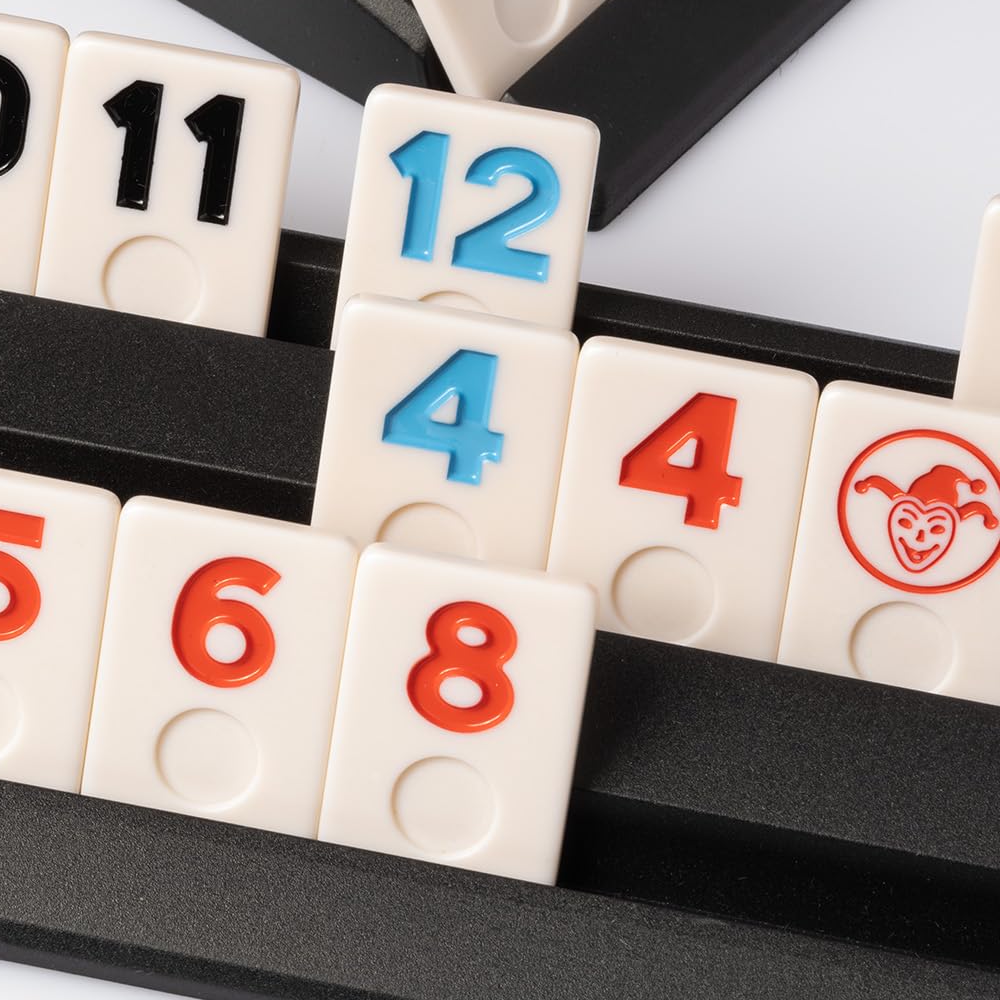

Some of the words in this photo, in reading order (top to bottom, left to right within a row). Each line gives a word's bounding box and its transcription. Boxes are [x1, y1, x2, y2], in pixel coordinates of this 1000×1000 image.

[103, 80, 245, 225] 11
[390, 131, 560, 281] 12
[383, 350, 503, 484] 4
[618, 392, 743, 531] 4
[171, 556, 281, 688] 6
[406, 600, 518, 734] 8
